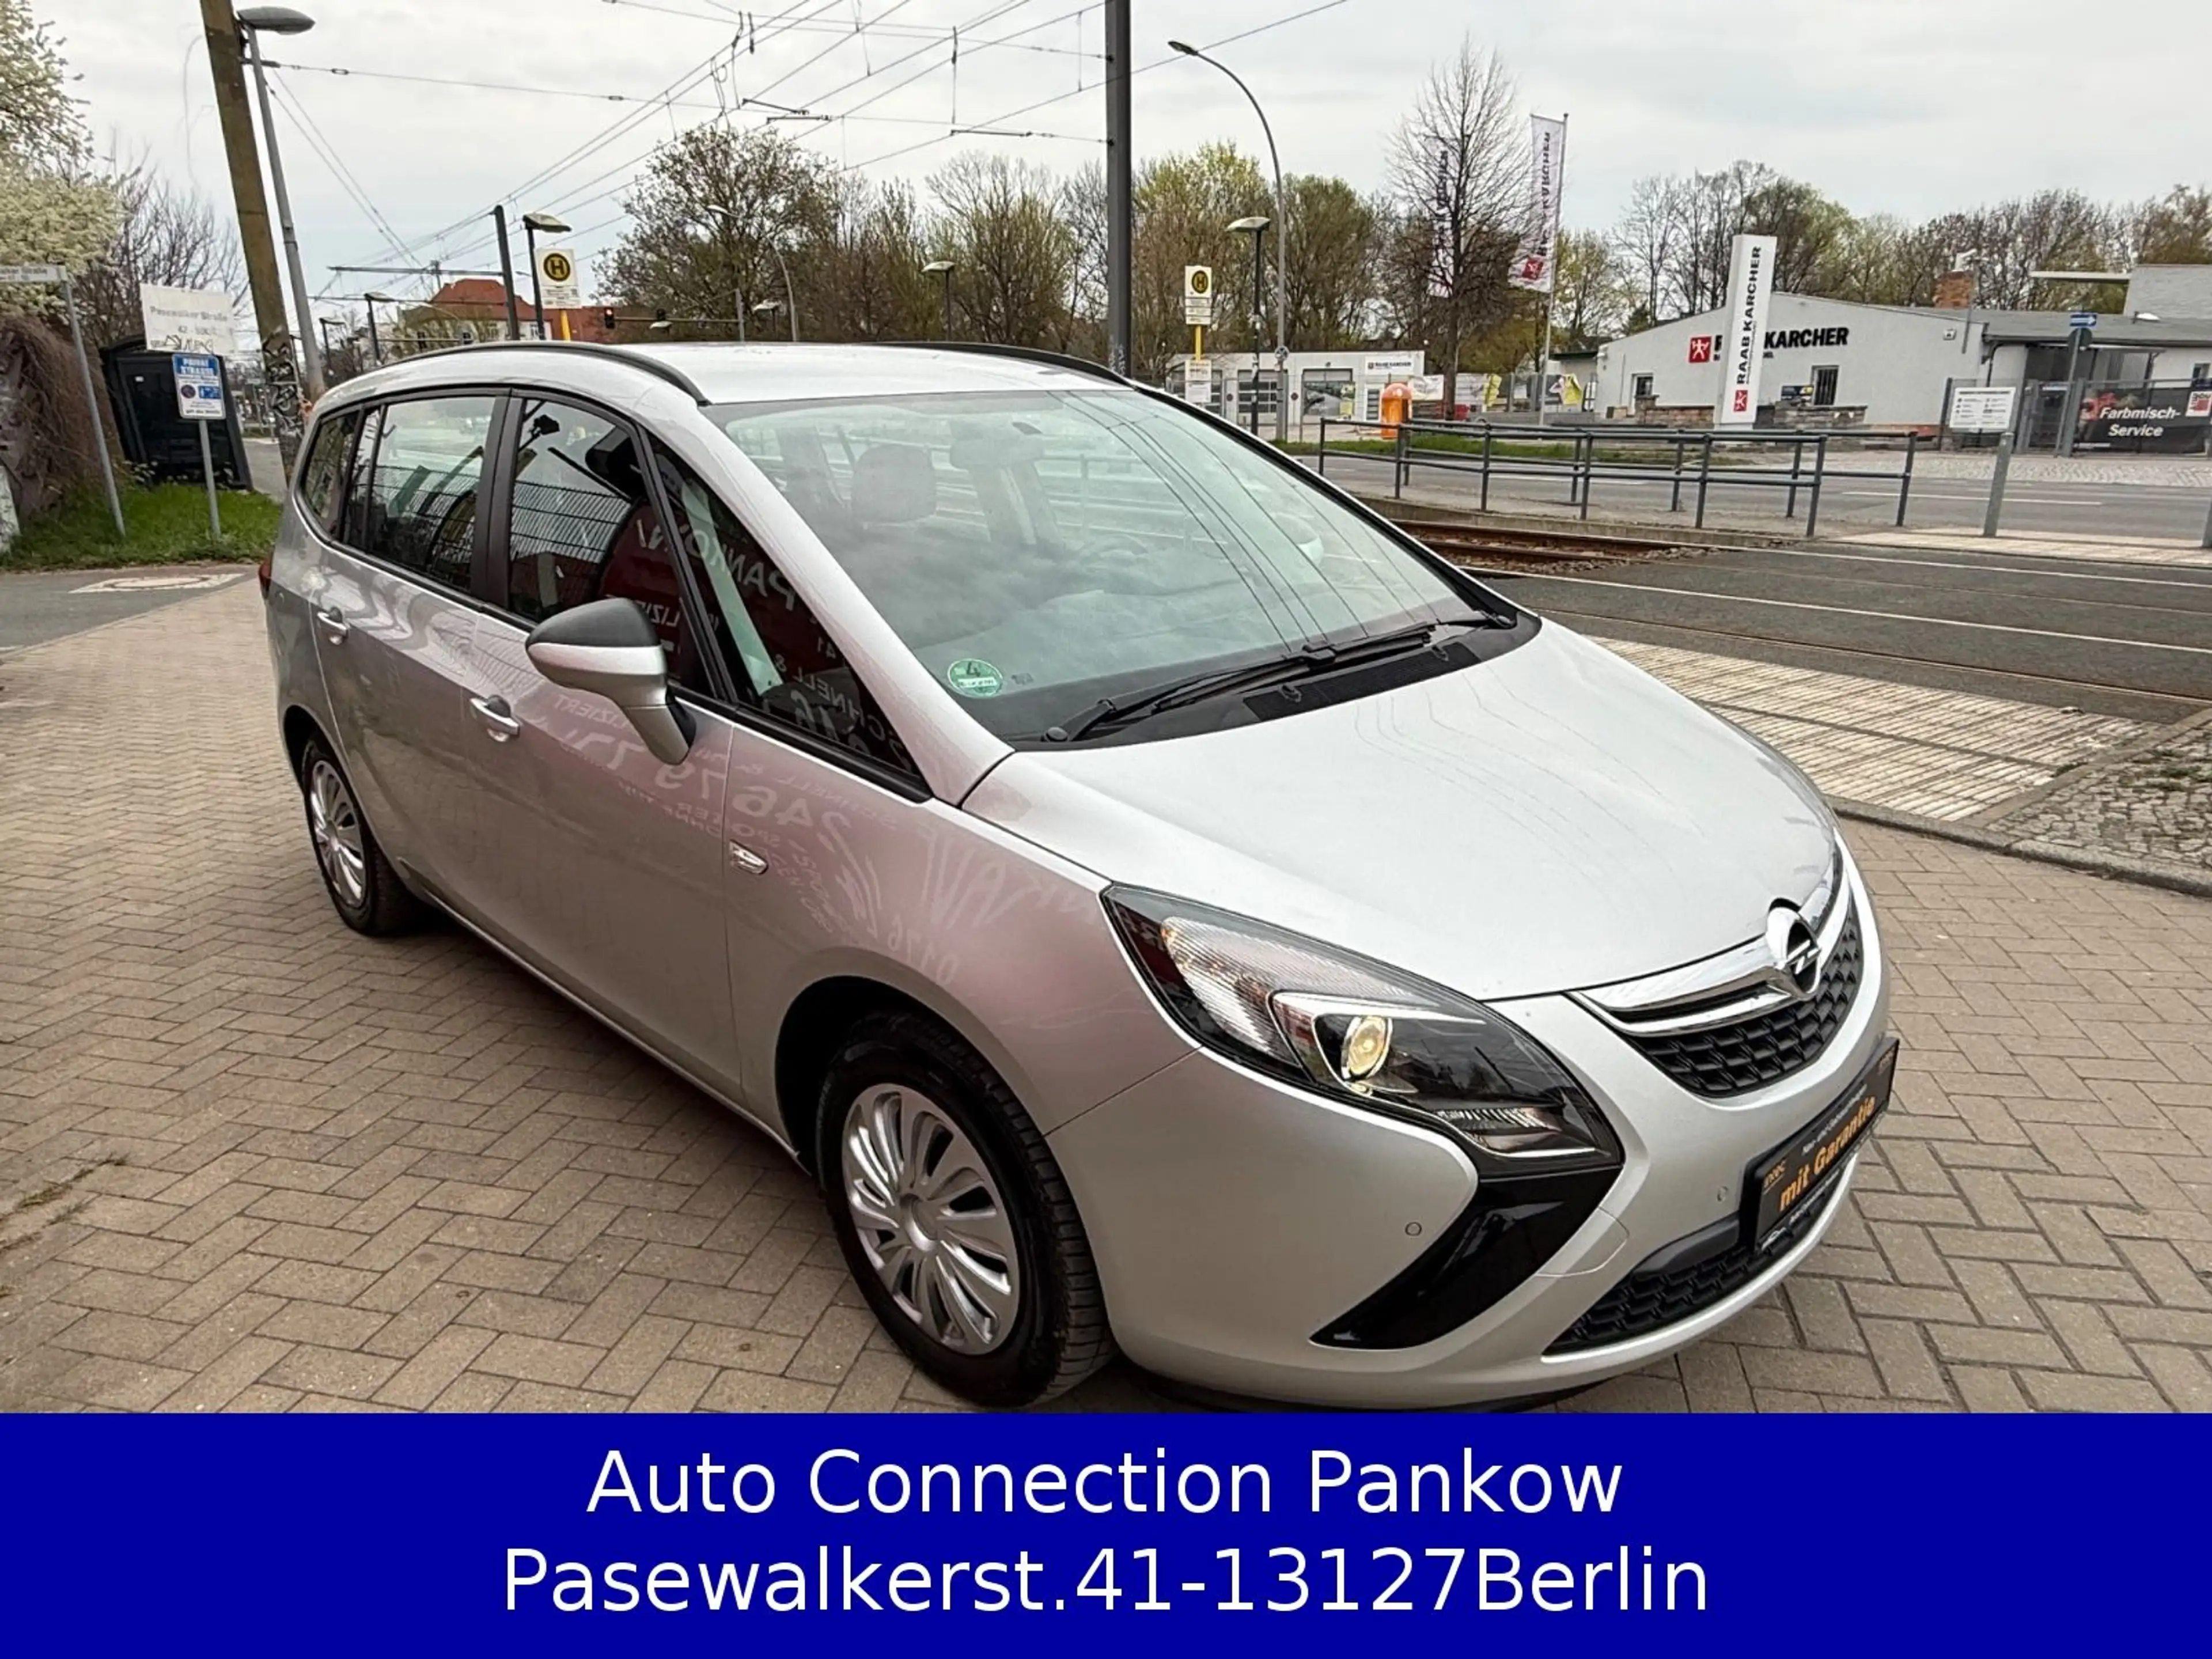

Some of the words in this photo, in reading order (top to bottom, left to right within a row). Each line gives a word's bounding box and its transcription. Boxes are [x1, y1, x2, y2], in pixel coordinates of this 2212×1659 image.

[551, 259, 565, 275] H
[1736, 336, 1750, 385] RAAB
[1743, 246, 1762, 332] KARCHER
[1764, 327, 1849, 349] KARCHER
[2100, 406, 2181, 420] Farbmisch-
[2108, 423, 2164, 437] Service
[1779, 1164, 1810, 1211] mit
[1814, 1096, 1876, 1176] Garantie
